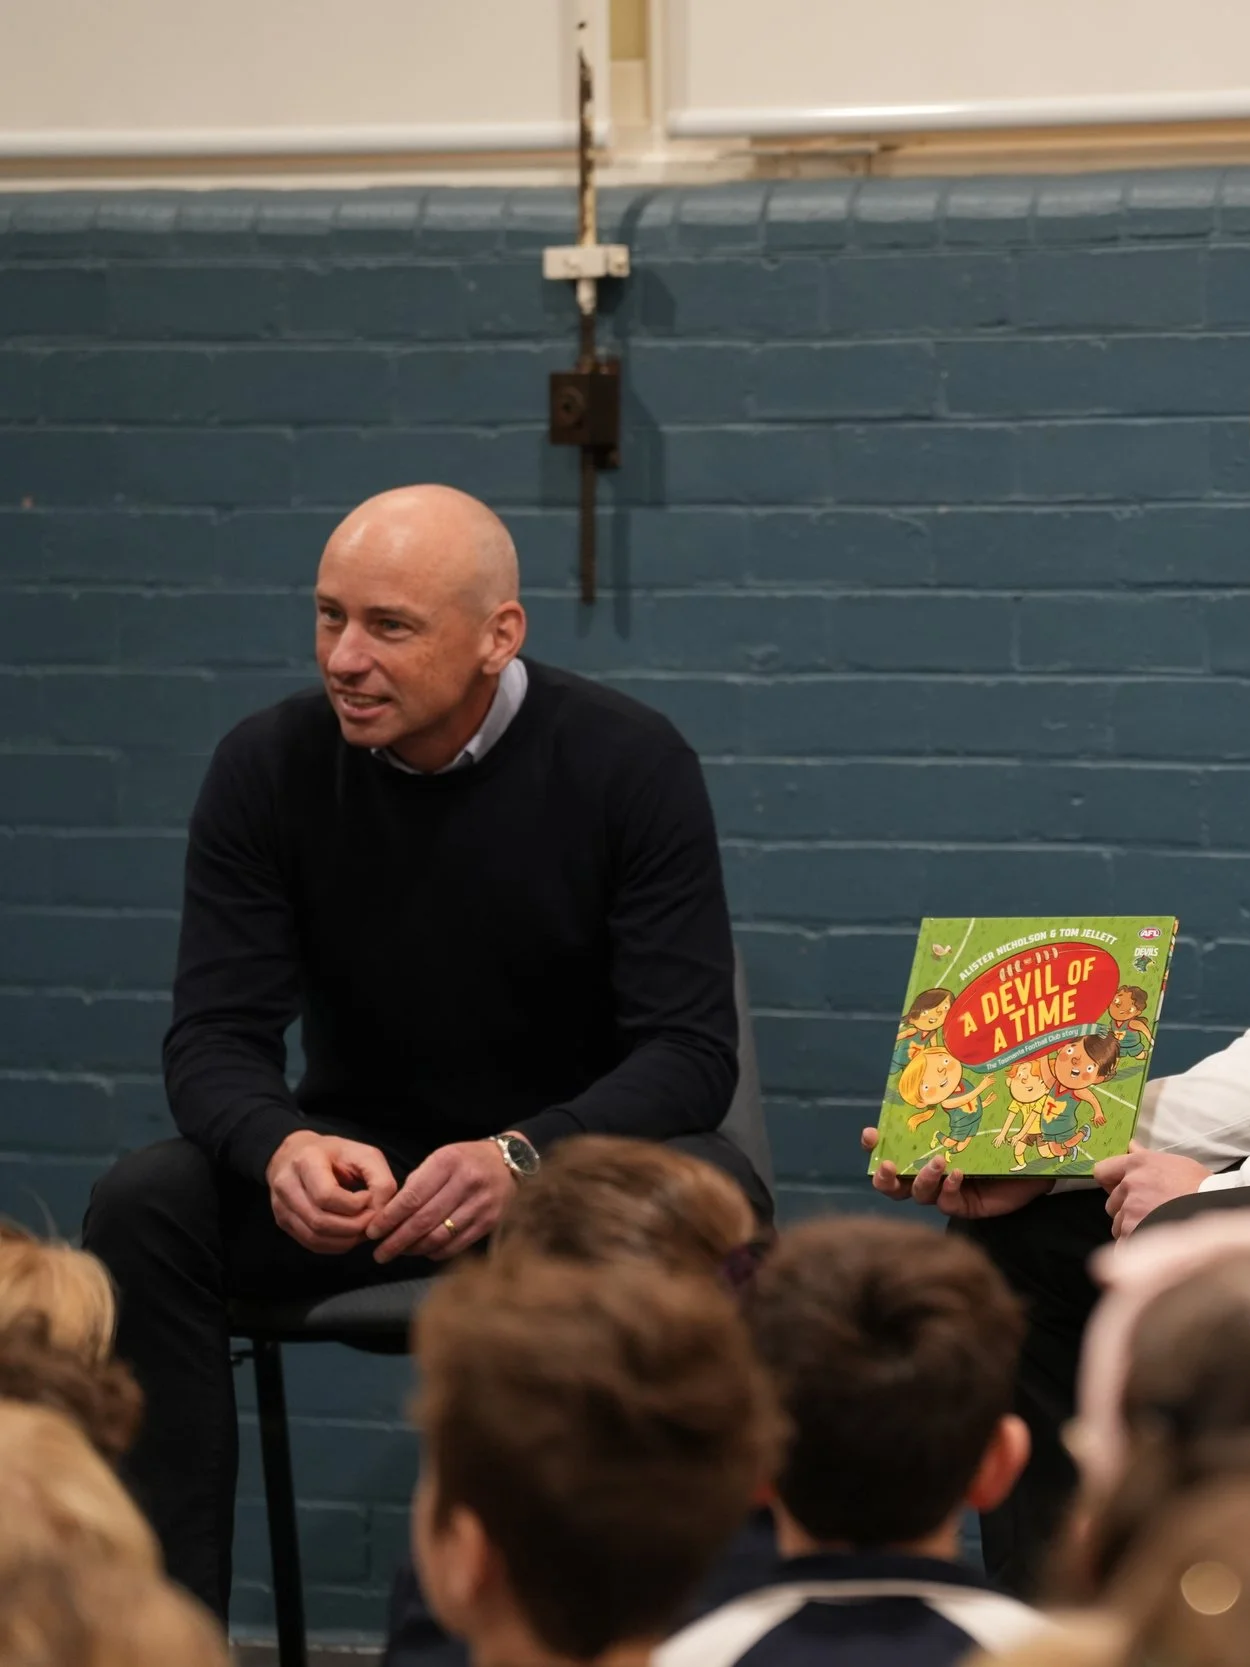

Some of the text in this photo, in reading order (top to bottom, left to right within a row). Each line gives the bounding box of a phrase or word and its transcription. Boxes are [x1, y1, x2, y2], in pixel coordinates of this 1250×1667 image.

[959, 928, 1118, 981] ALISTER NICHOLSON & TOM JELLETT
[1134, 947, 1159, 957] DEVILS
[963, 956, 1096, 1037] A DEVIL OF
[993, 988, 1077, 1053] A TIME
[986, 1028, 1079, 1071] The Tasmania Football Club story
